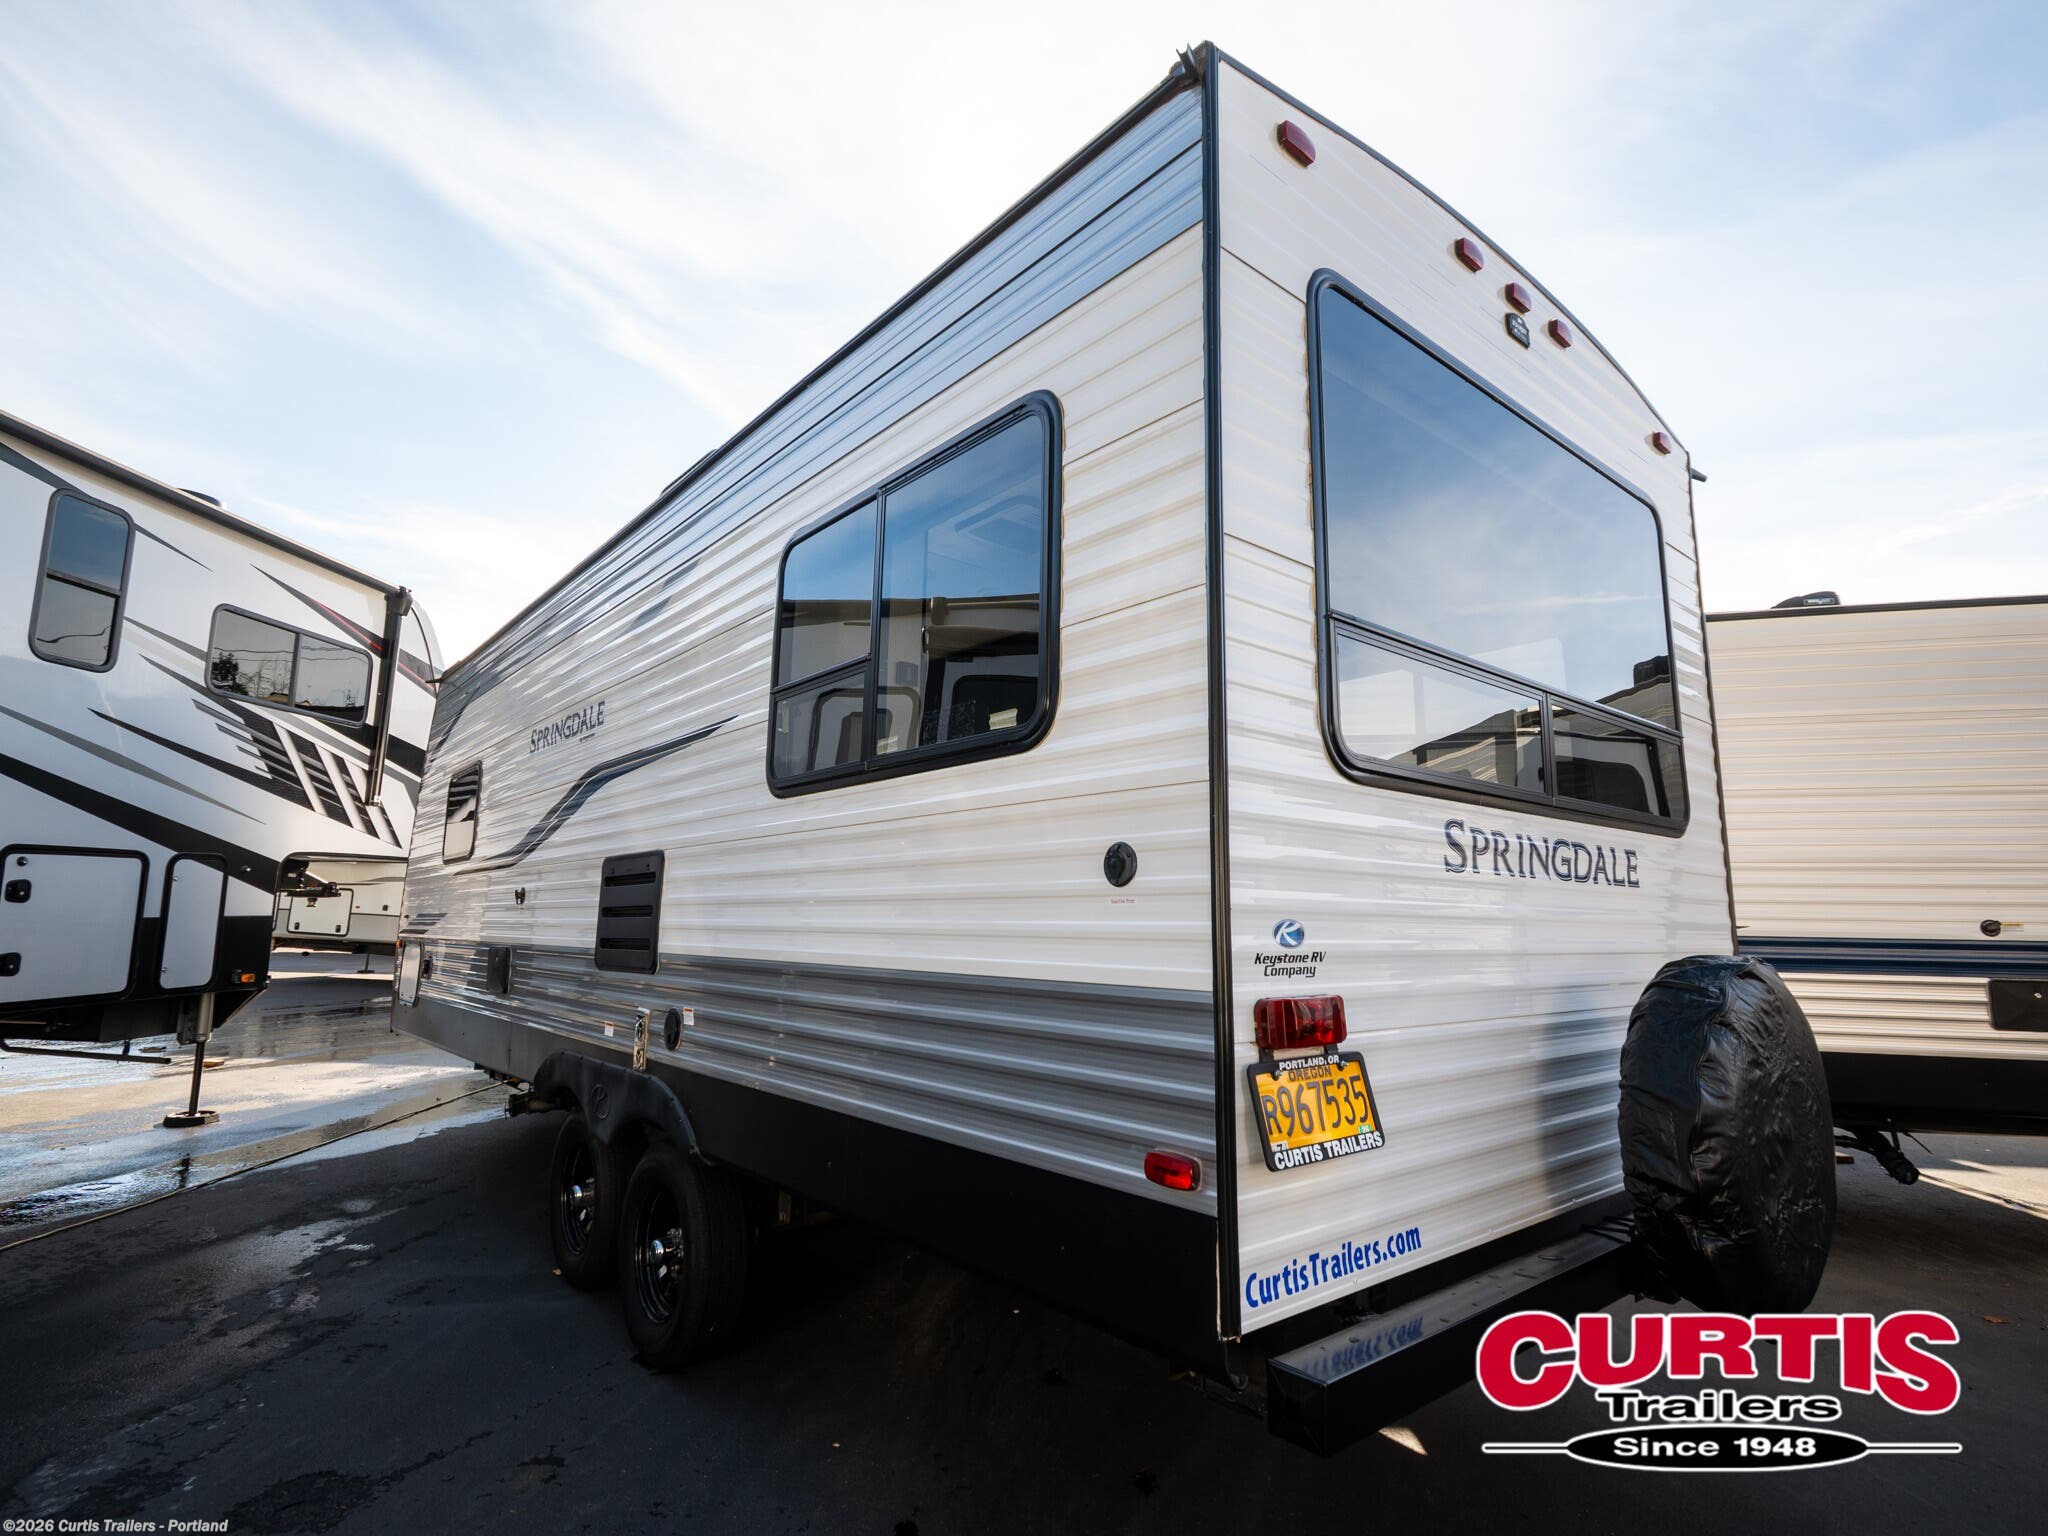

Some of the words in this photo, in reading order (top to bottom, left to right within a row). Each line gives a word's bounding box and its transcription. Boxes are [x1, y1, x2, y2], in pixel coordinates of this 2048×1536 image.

[530, 700, 605, 753] SPRINGDALE
[1444, 818, 1640, 888] SPRINGDALE
[1254, 952, 1308, 966] Keystone
[1310, 951, 1327, 963] RV
[1264, 964, 1316, 978] Company
[1288, 1065, 1332, 1082] OREGON
[1328, 1054, 1340, 1064] OR
[1262, 1074, 1369, 1138] R967535
[1274, 1145, 1324, 1170] CURTIS
[1324, 1131, 1383, 1157] TRAILERS
[1245, 1226, 1422, 1308] CurtisTrailers.com
